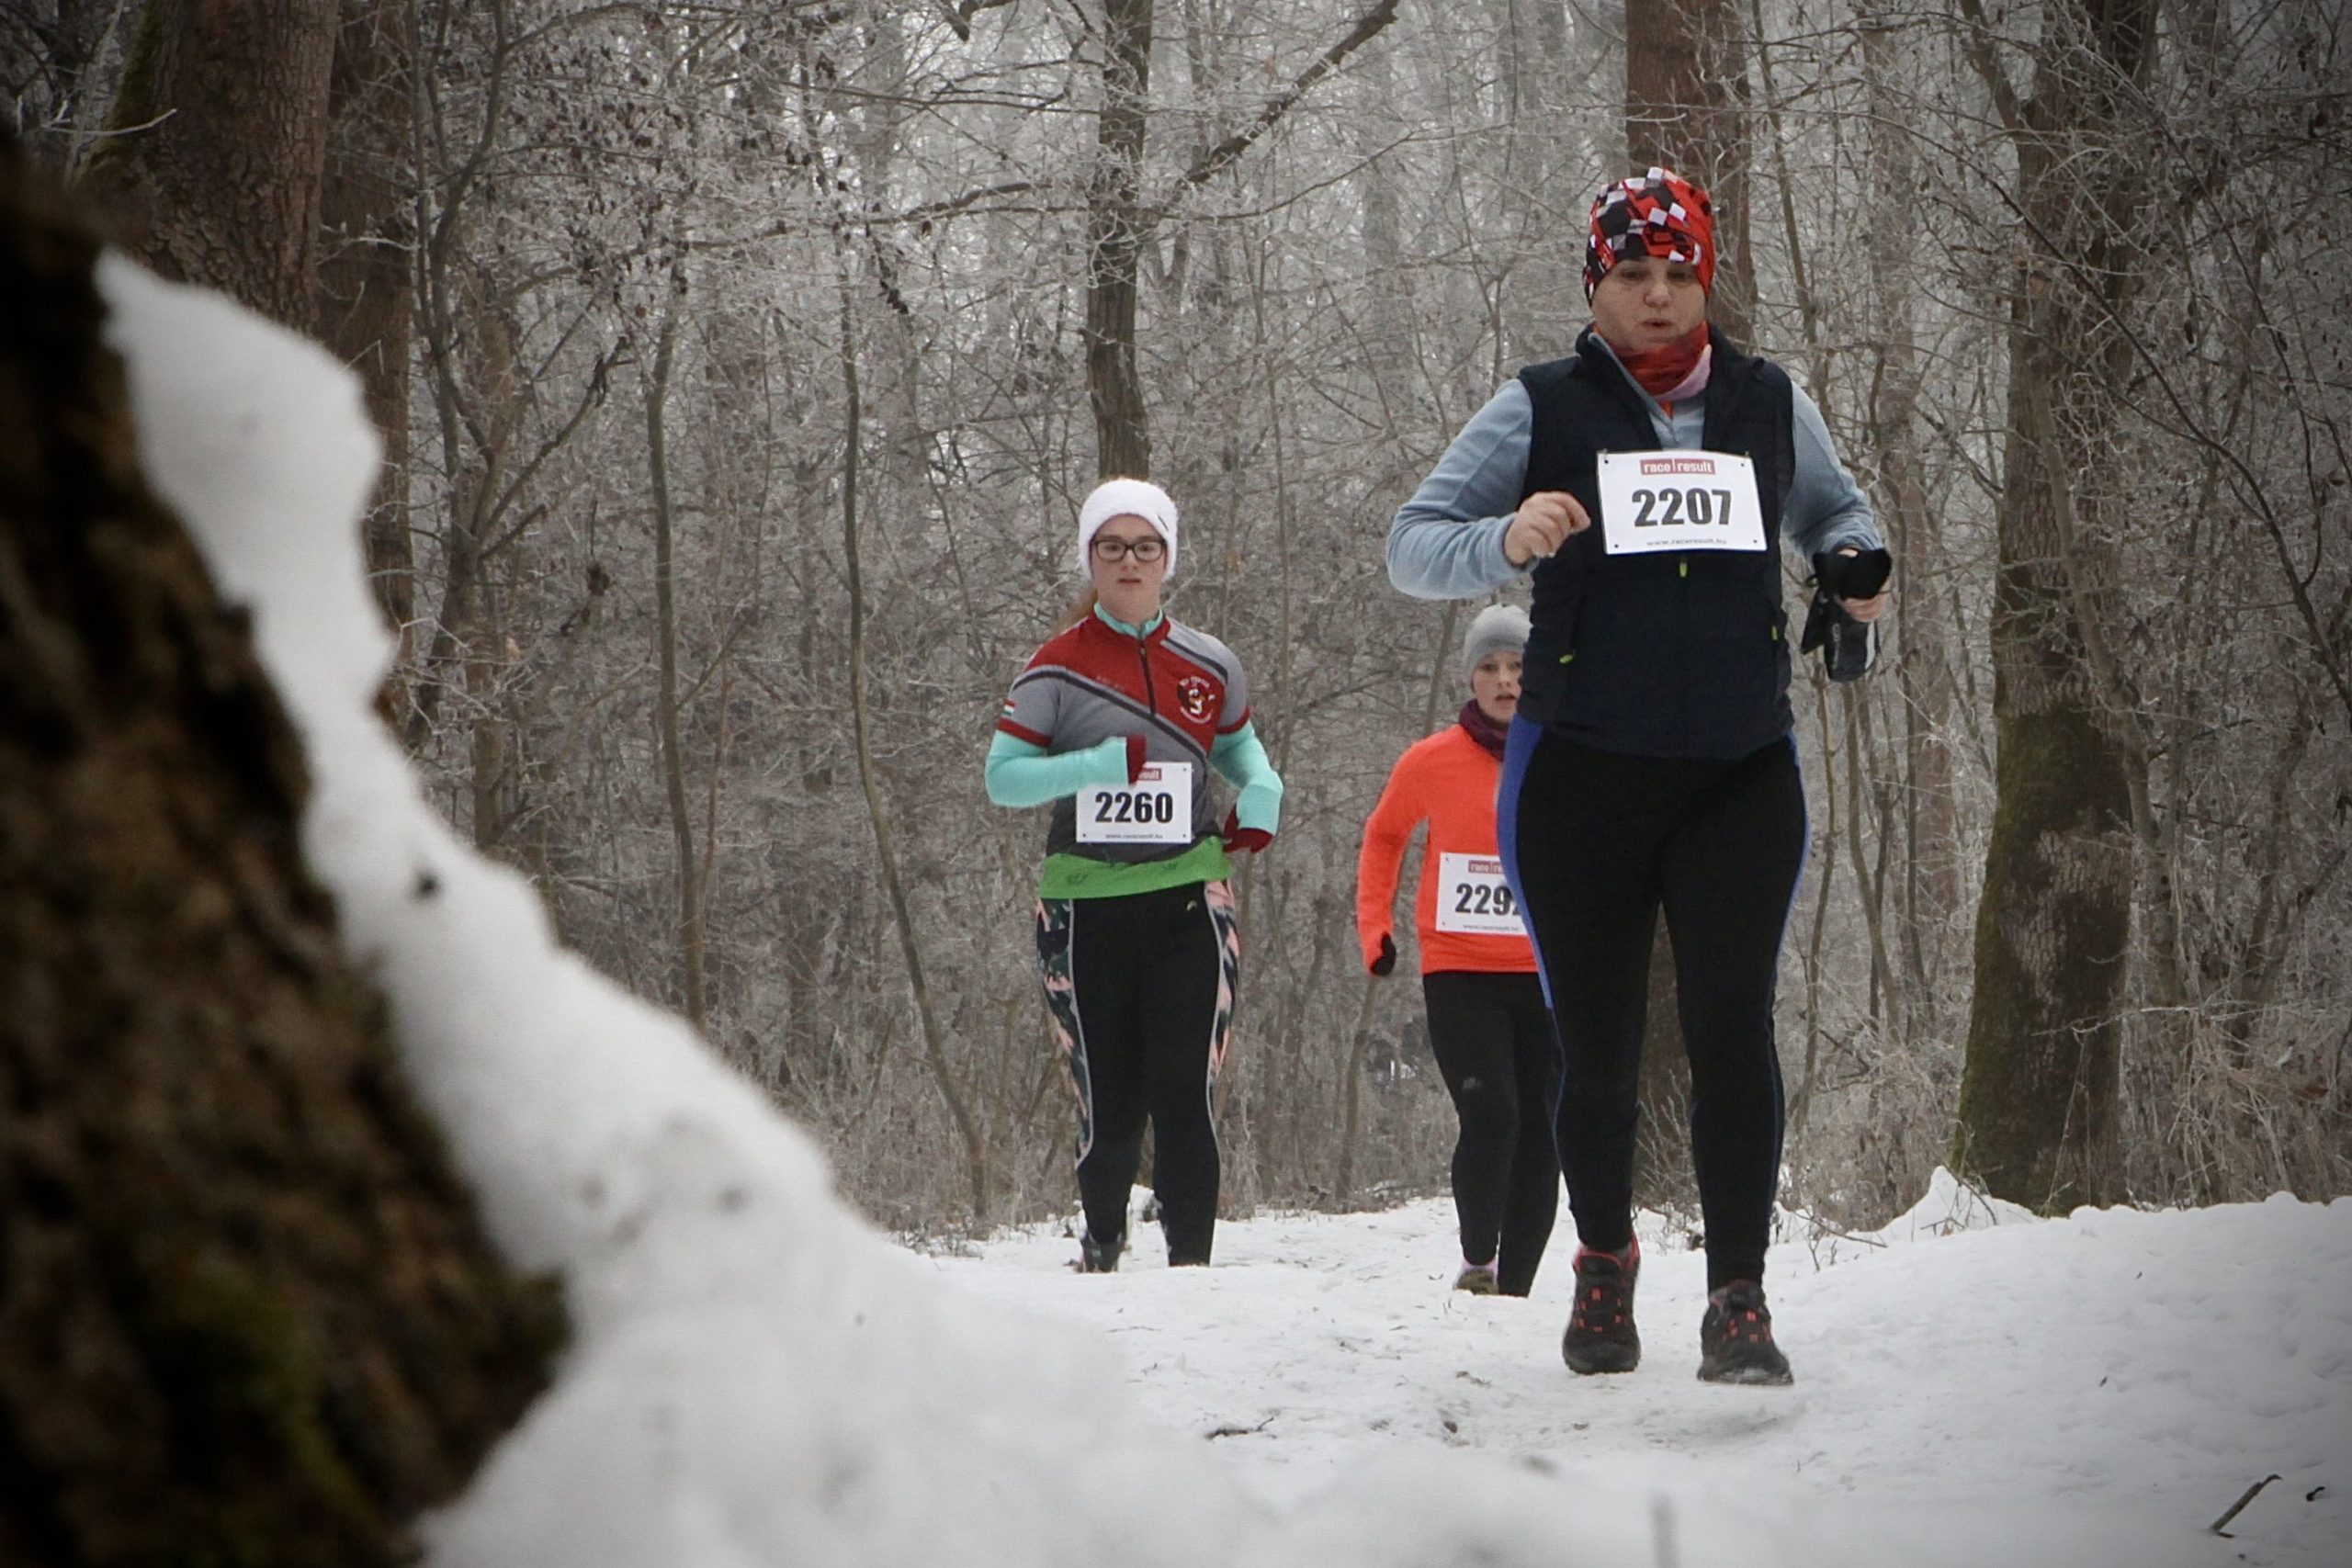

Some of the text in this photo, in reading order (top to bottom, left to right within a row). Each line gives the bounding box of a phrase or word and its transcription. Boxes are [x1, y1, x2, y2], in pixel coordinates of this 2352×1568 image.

[1644, 461, 1713, 473] race result
[1632, 488, 1731, 527] 2207
[1095, 791, 1173, 823] 2260
